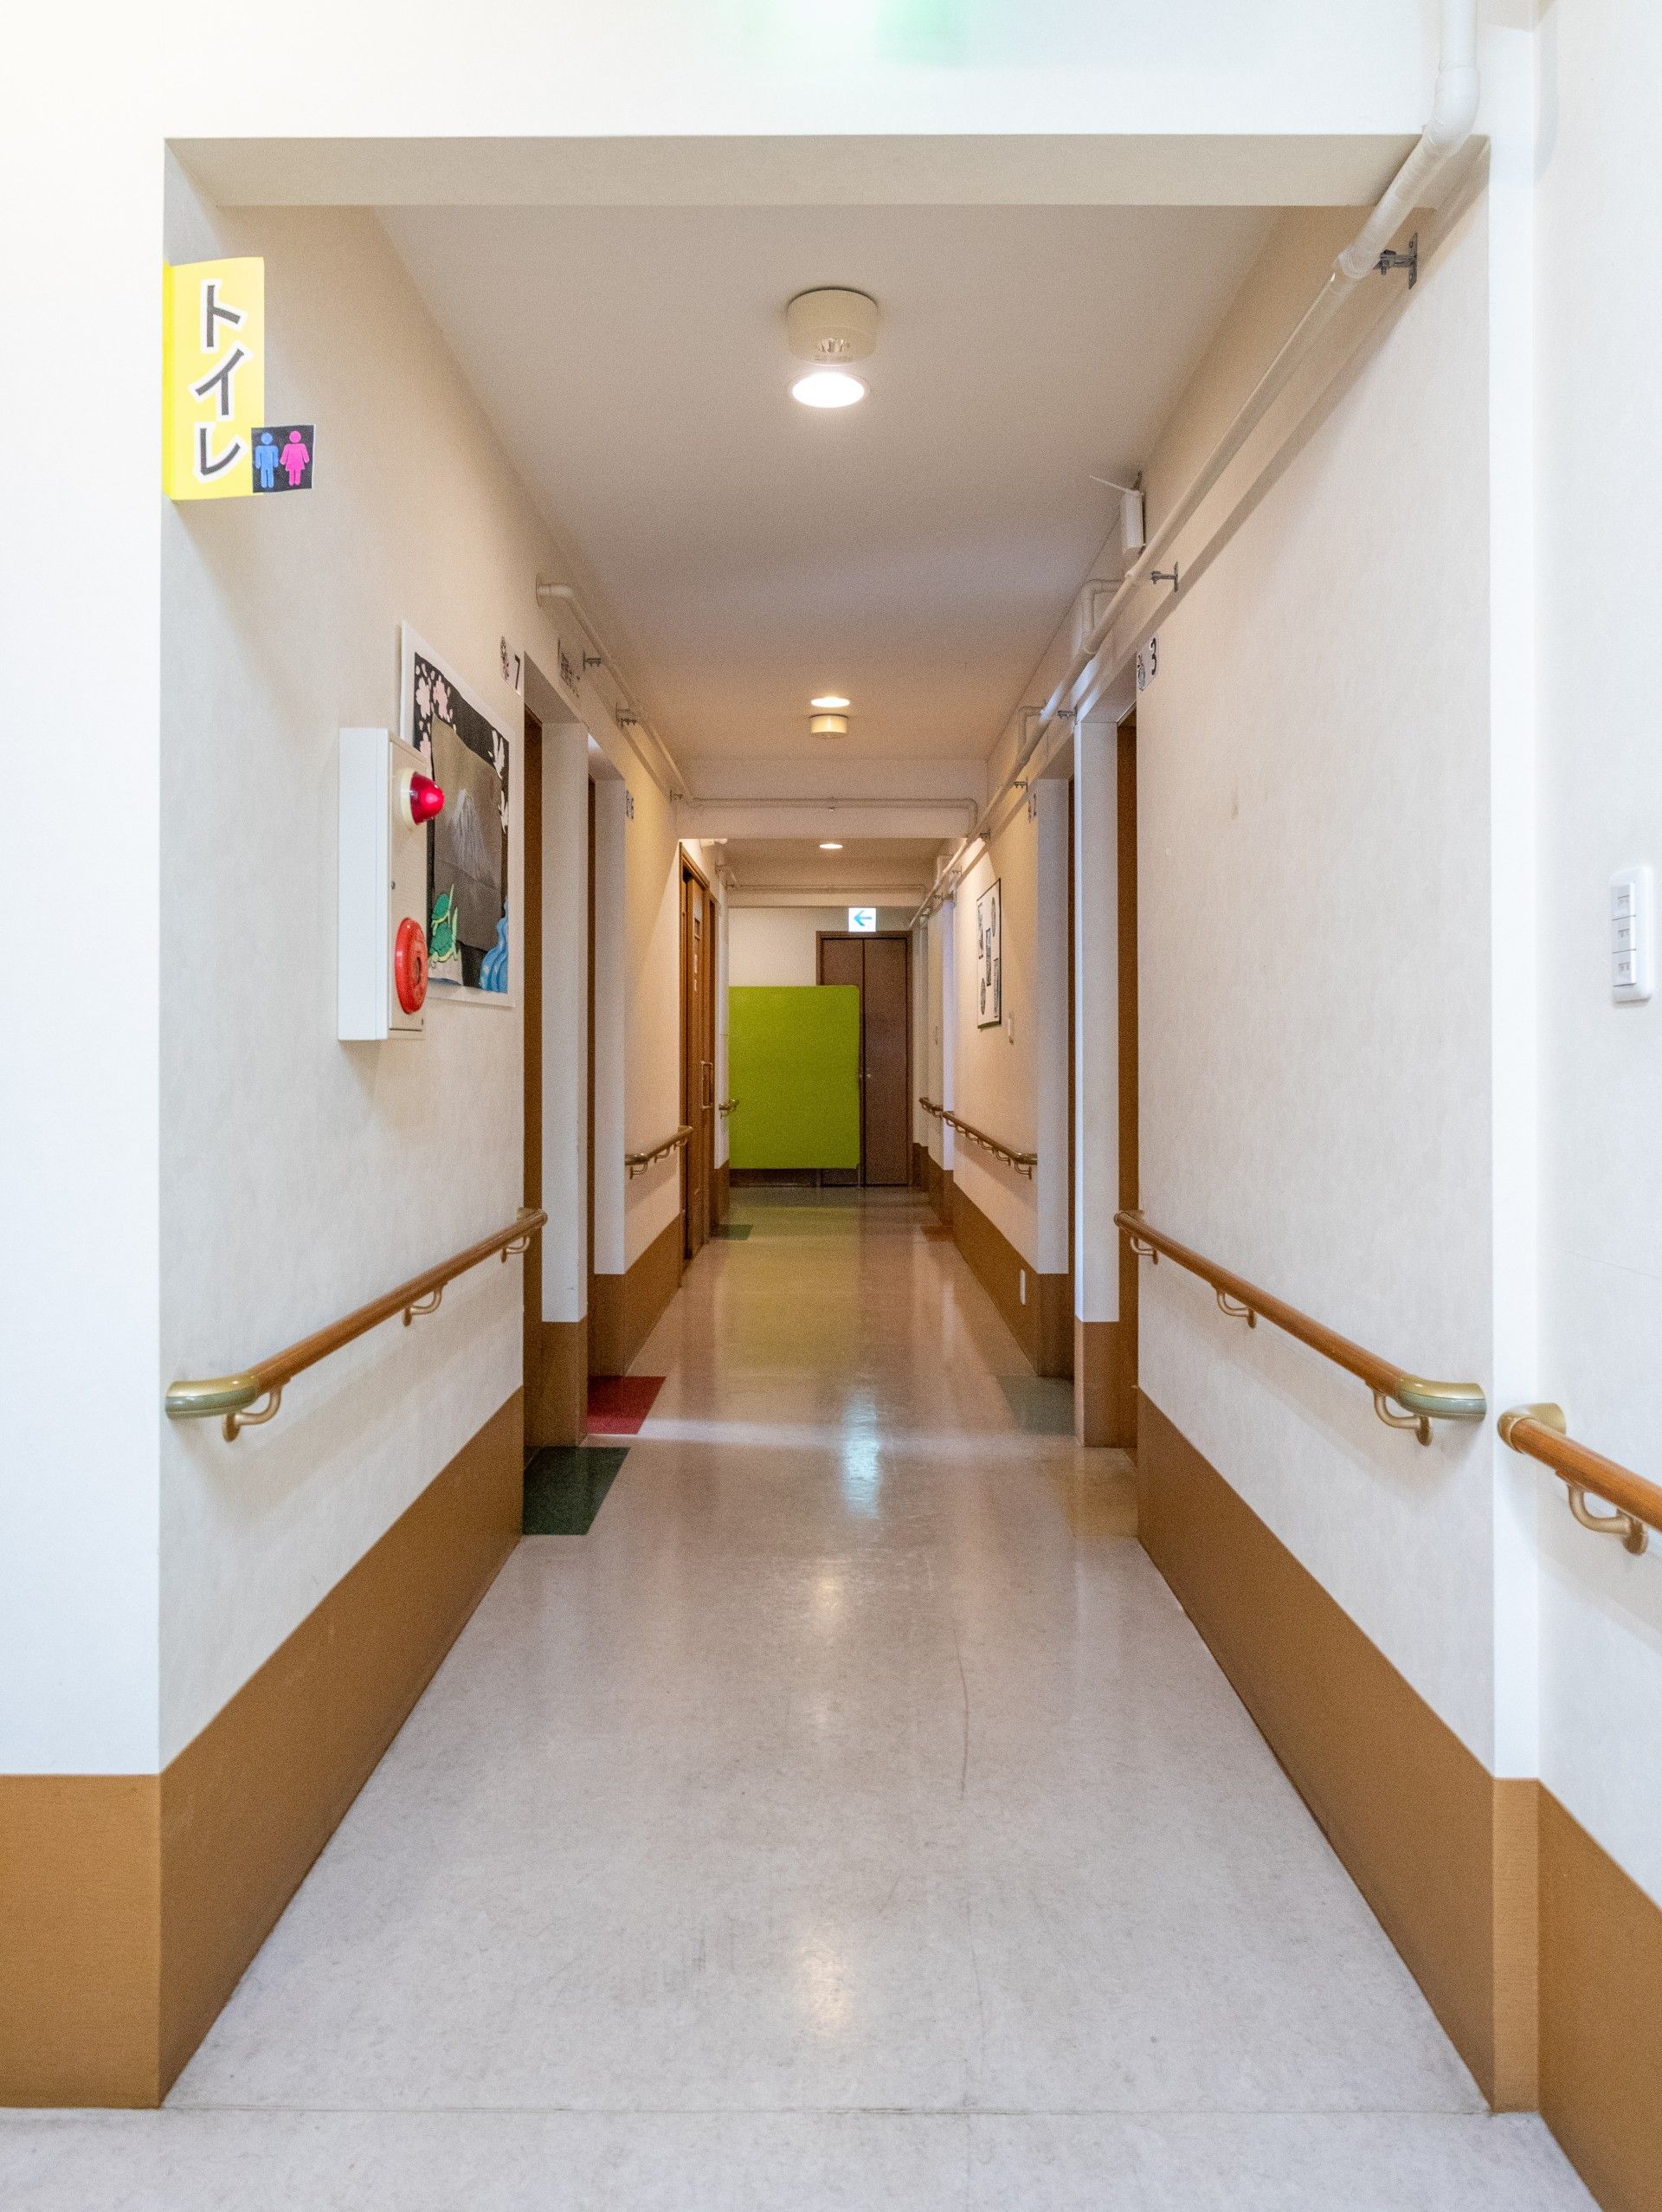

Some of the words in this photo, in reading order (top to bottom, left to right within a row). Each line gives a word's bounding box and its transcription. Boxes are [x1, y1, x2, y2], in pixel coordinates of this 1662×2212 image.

[195, 284, 245, 476] トイレ
[515, 654, 521, 690] 7
[1150, 637, 1157, 675] 3
